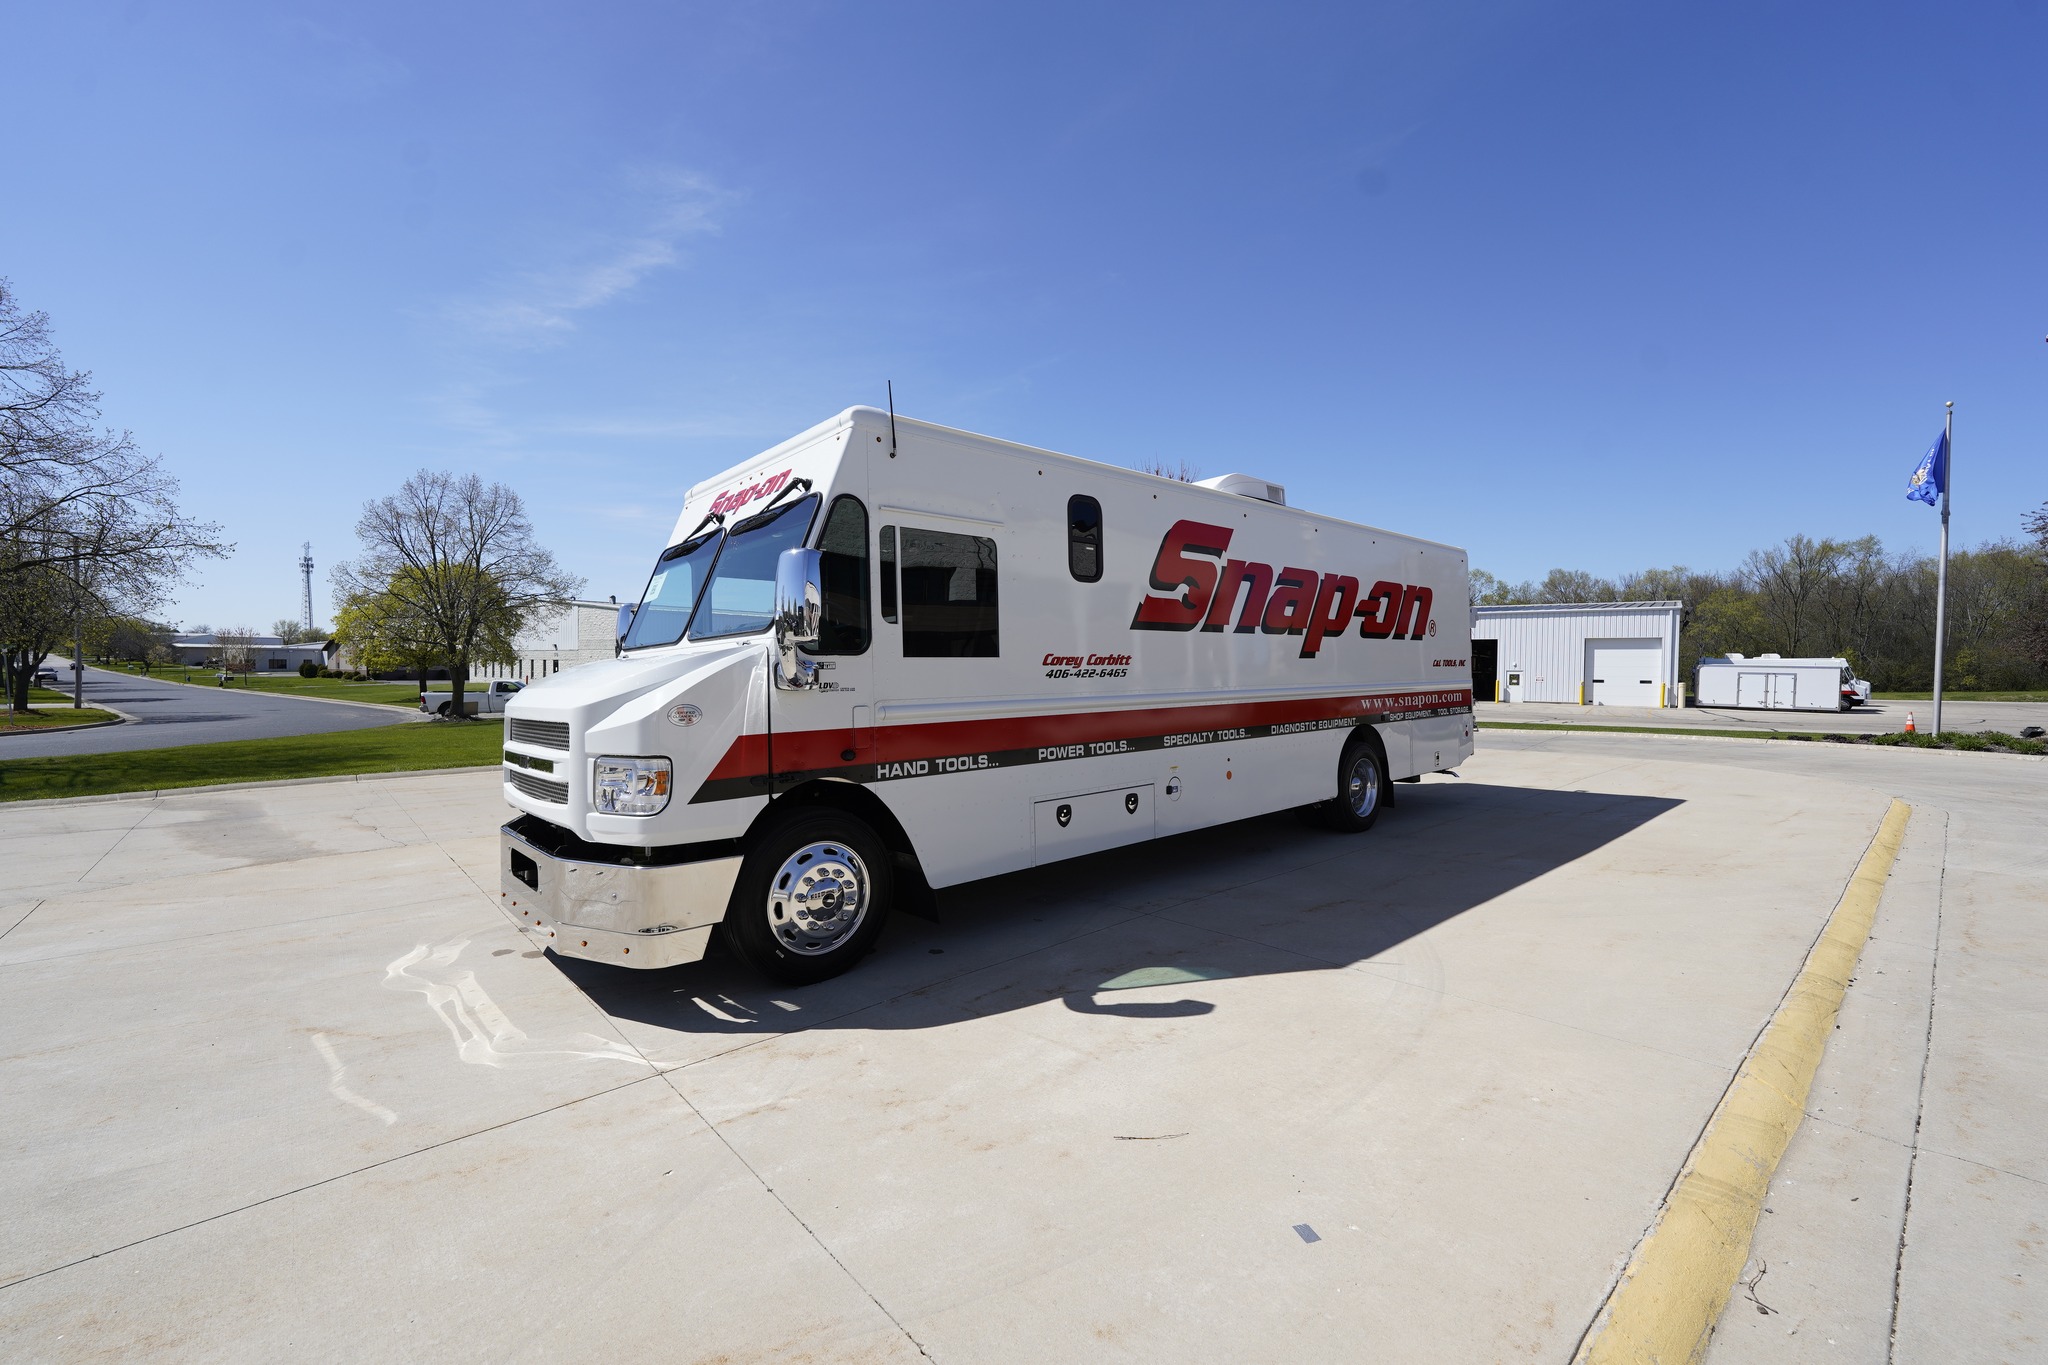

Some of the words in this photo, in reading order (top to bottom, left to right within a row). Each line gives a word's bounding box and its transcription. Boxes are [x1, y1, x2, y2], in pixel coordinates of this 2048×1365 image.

[705, 468, 792, 517] Snap-on
[1042, 653, 1084, 669] Corey
[1086, 653, 1132, 666] Corbitt
[1045, 668, 1128, 679] 406-422-6465
[818, 681, 834, 689] LDV
[1361, 692, 1463, 710] www.snapon.com
[1389, 713, 1404, 721] SHOP
[1437, 708, 1449, 716] TOOL
[1270, 721, 1316, 735] DIAGNOSTIC
[1163, 731, 1214, 747] SPECIALTY
[1038, 744, 1084, 761] POWER
[1089, 740, 1135, 755] TOOLS...
[877, 760, 929, 779] HAND
[936, 755, 999, 772] TOOLS...
